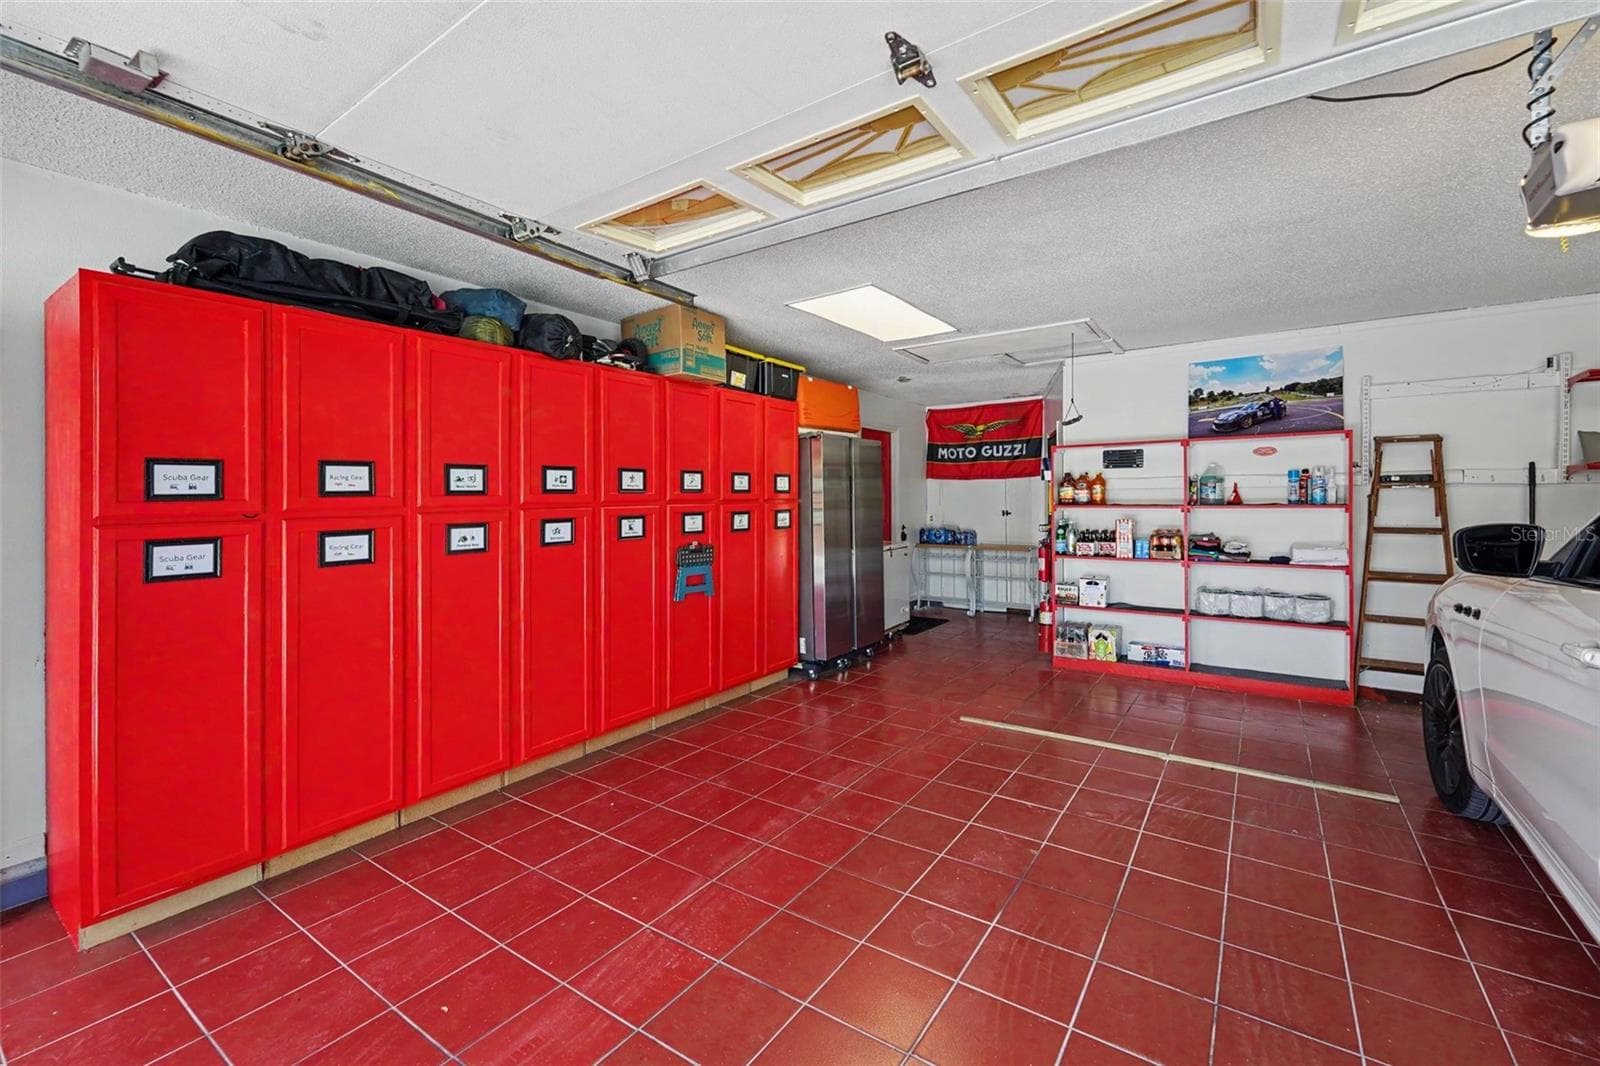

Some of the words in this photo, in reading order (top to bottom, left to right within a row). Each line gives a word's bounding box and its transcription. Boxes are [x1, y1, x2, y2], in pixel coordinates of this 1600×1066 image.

[938, 446, 977, 459] MOTO
[981, 443, 1027, 457] GUZZI
[329, 474, 349, 482] Racing
[159, 554, 185, 563] Scuba
[186, 553, 207, 561] Gear
